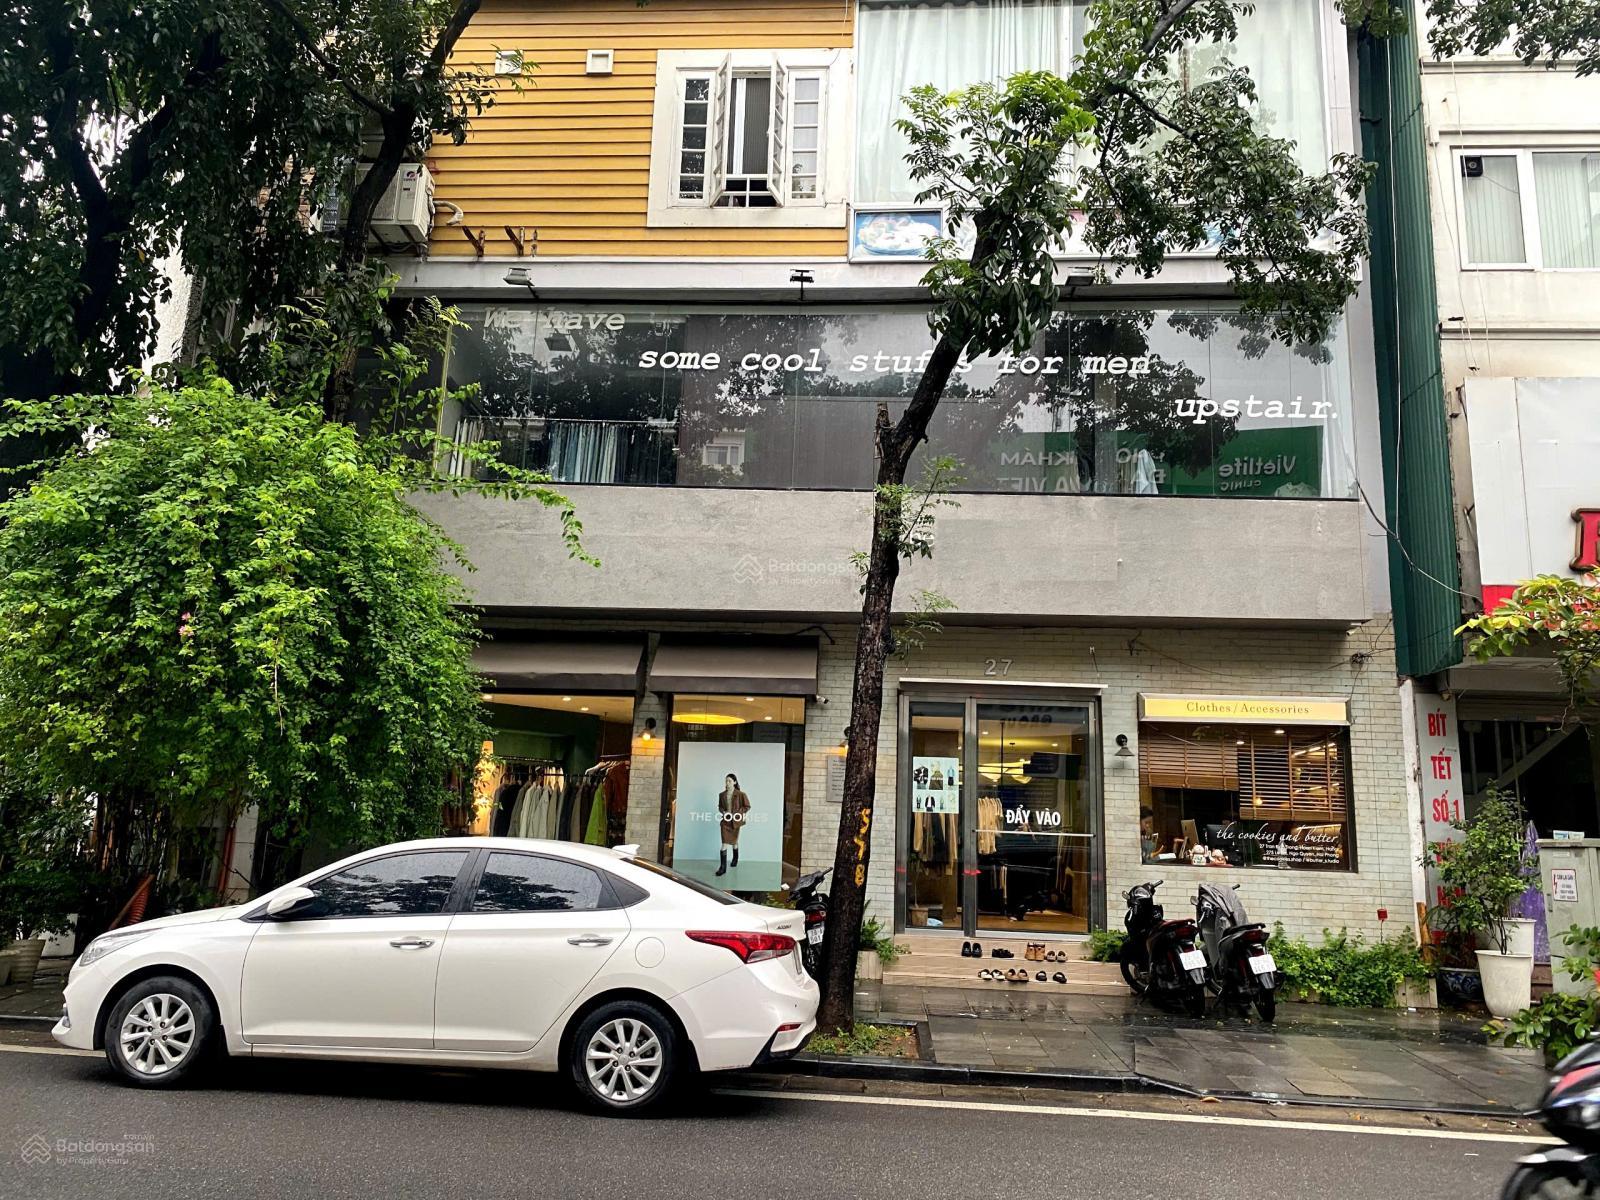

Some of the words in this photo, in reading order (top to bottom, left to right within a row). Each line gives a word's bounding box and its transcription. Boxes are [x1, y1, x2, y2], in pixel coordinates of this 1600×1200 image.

[484, 307, 522, 328] We
[541, 307, 626, 331] have
[639, 350, 721, 370] some
[741, 348, 823, 372] cool
[849, 349, 973, 373] stufs
[998, 352, 1064, 375] for
[1083, 355, 1151, 375] men
[1175, 394, 1338, 425] upstair.
[985, 659, 1012, 675] 27
[1427, 707, 1447, 737] BÍT
[1430, 747, 1452, 780] TẾT
[688, 811, 713, 822] THE
[1005, 804, 1031, 824] ĐẨY
[1035, 808, 1061, 826] VÀO
[1432, 789, 1449, 823] SỐ
[1216, 821, 1236, 839] the
[1237, 822, 1277, 842] cookies
[1279, 824, 1304, 843] and
[1304, 826, 1340, 843] butter
